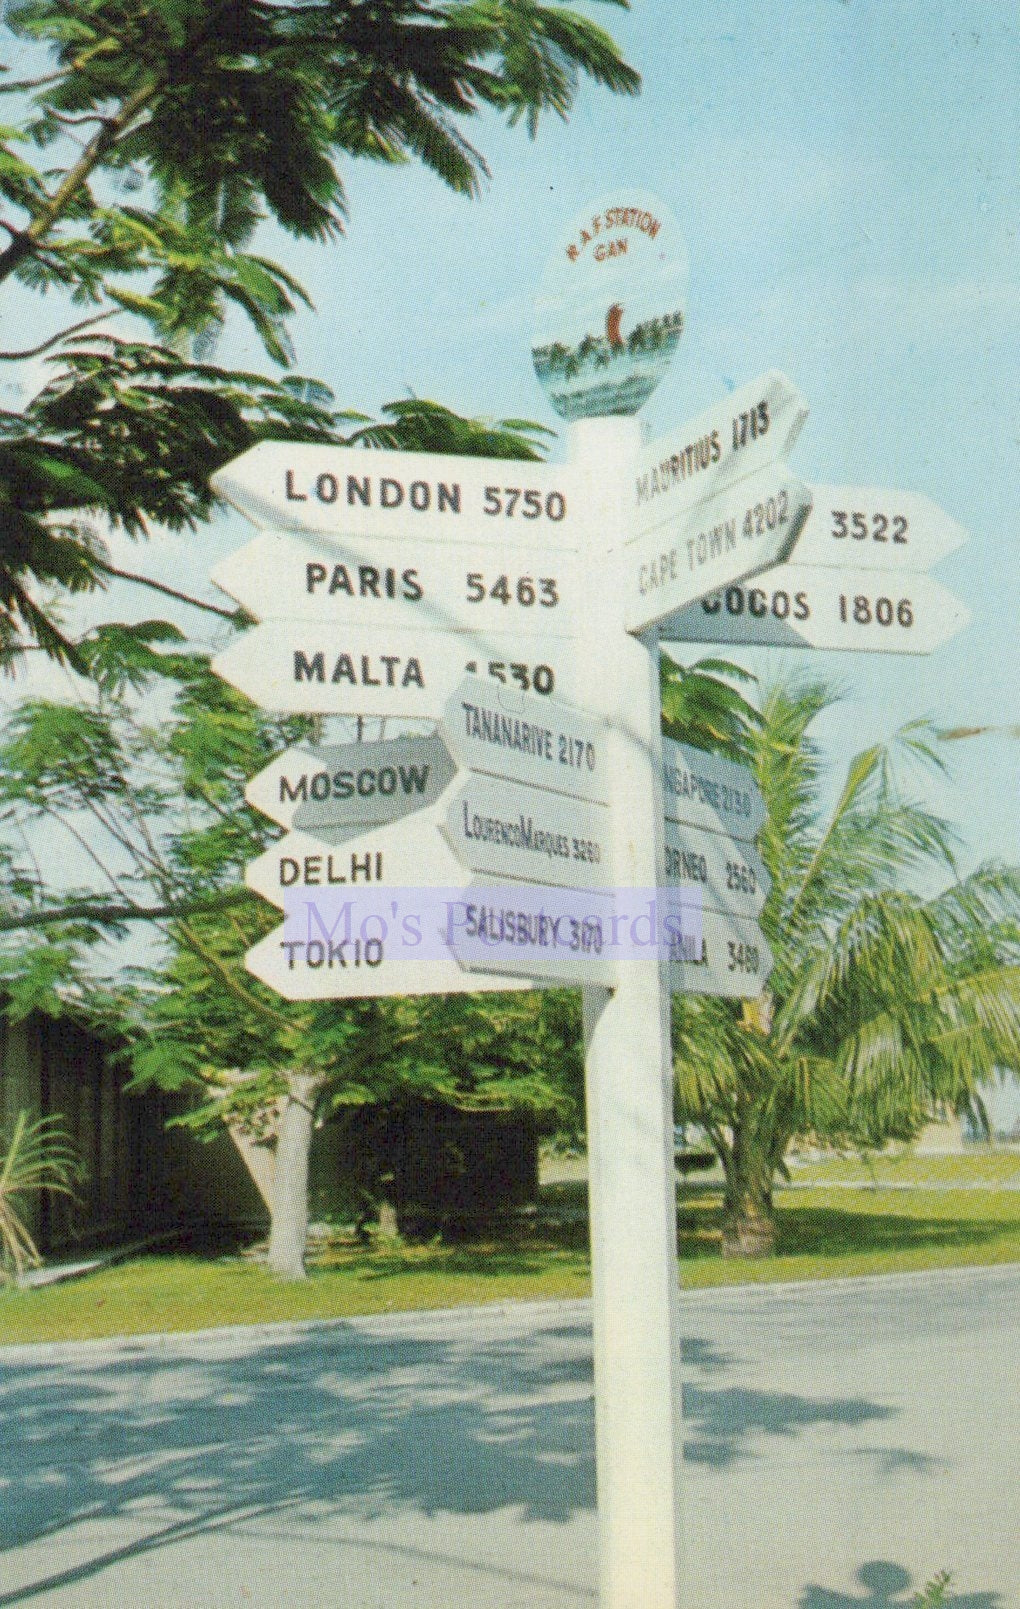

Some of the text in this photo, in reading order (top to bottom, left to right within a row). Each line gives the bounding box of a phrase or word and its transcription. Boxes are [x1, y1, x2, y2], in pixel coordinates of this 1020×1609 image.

[605, 207, 661, 239] STATION
[594, 238, 628, 262] GAN
[635, 429, 721, 506] MAURITIUS
[285, 469, 567, 521] LONDON 5750
[638, 489, 790, 597] CAPE TOWN 4202
[831, 510, 909, 544] 3522
[305, 563, 560, 607] PARIS 5463
[839, 594, 914, 628] 1806
[293, 651, 425, 688] MALTA
[461, 701, 596, 772] TANANARIVE 2170
[279, 764, 430, 803] MOSCOW
[279, 852, 383, 886] DELHI
[465, 904, 560, 949] SALISBURY
[280, 938, 383, 969] TOKIO
